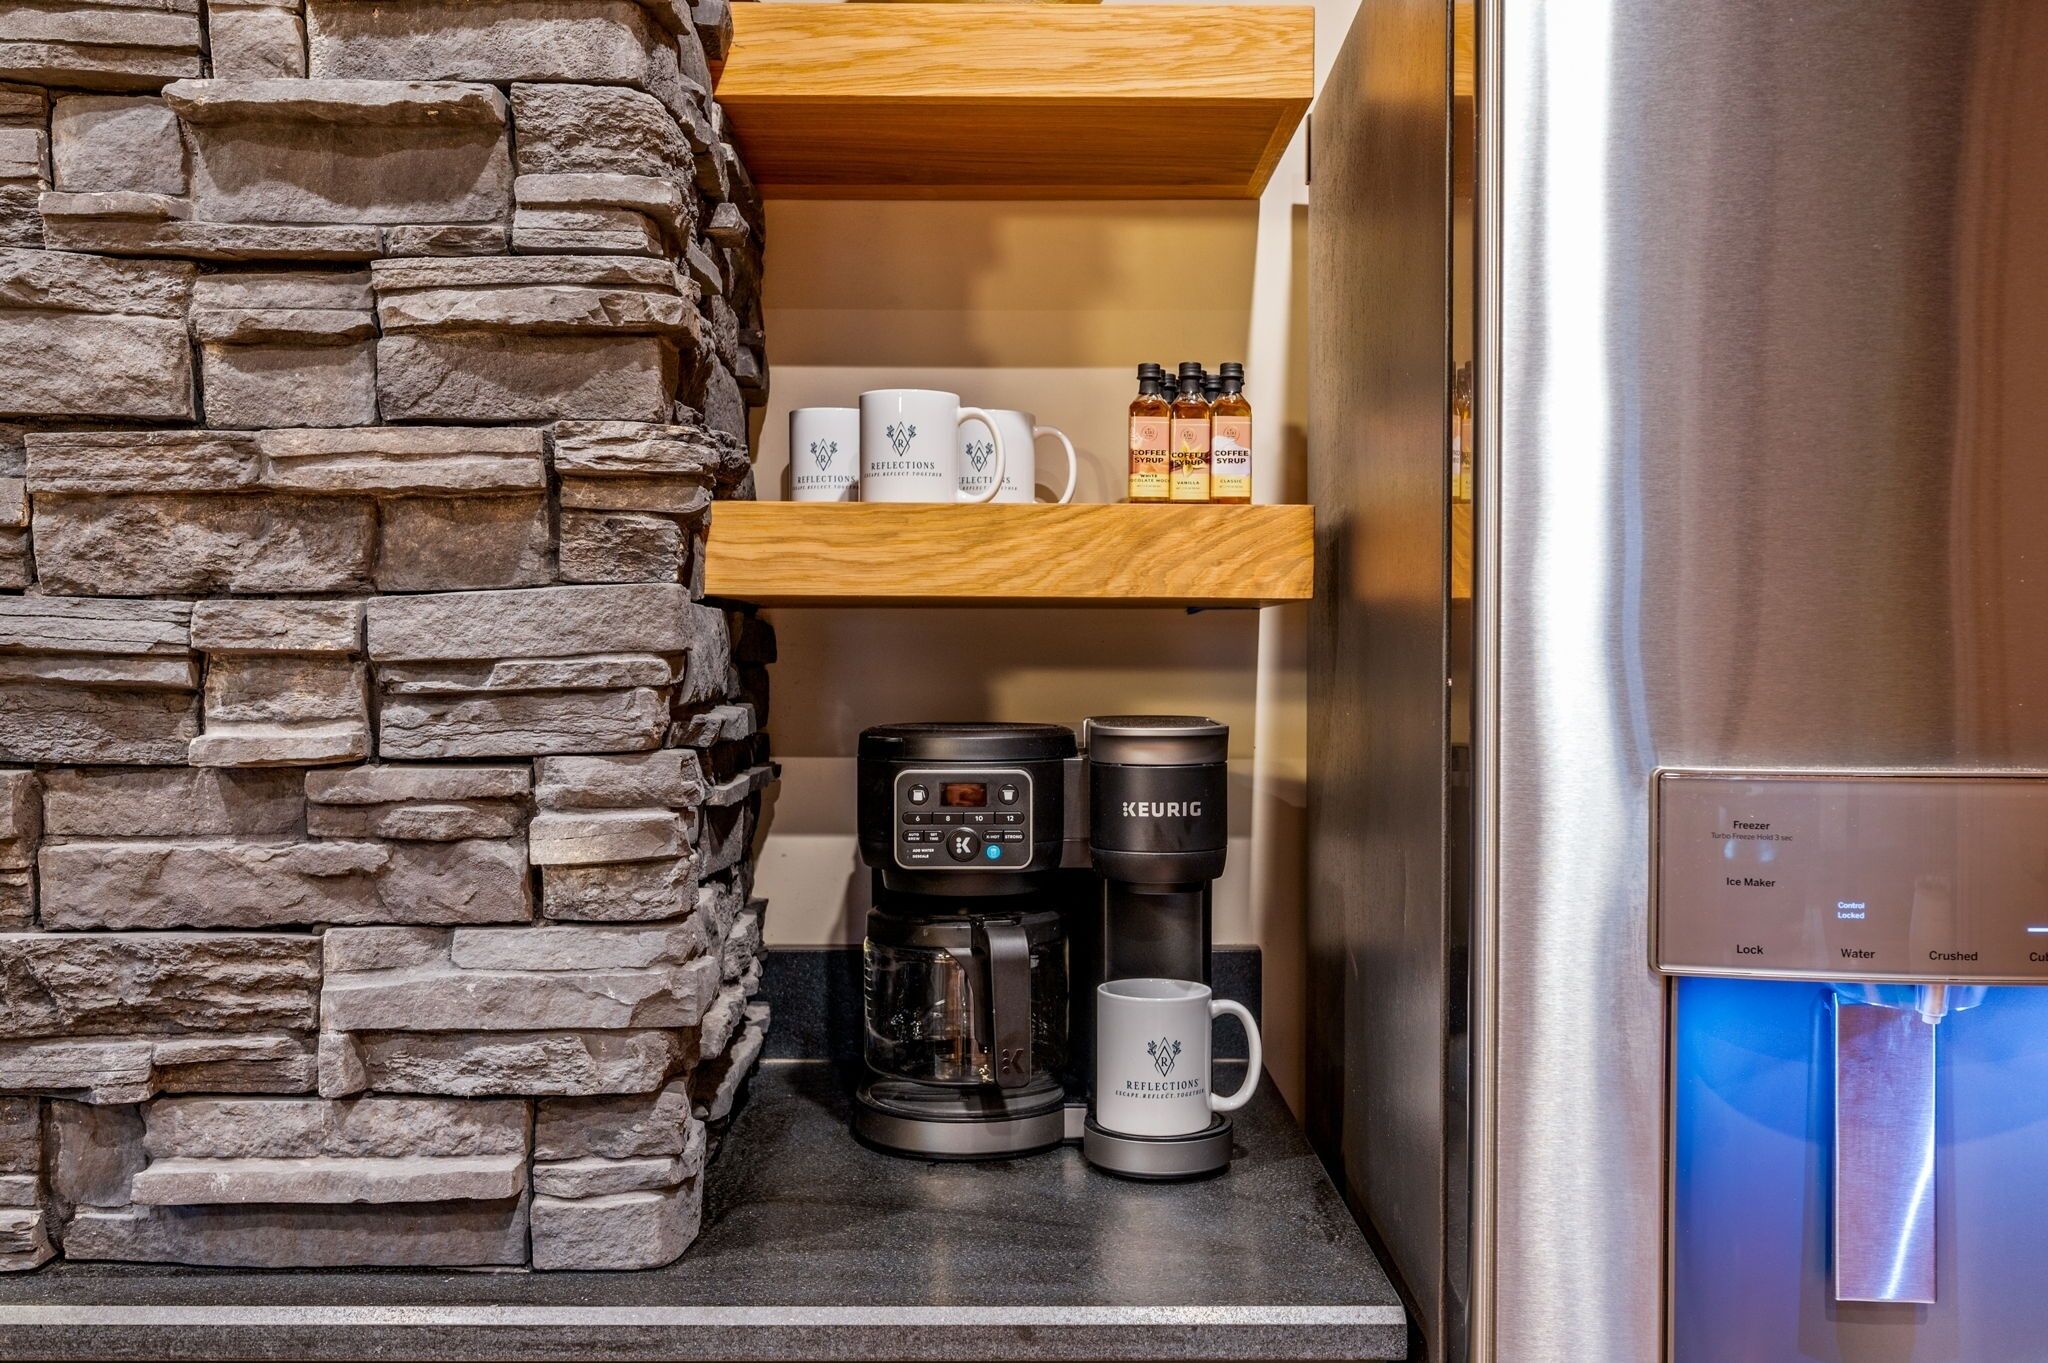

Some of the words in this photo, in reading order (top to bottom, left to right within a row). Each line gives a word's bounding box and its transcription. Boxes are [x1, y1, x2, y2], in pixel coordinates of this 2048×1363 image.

[1214, 449, 1249, 457] COFFEE
[871, 461, 935, 470] REFLECTIONS
[797, 475, 856, 484] REFLECTIONS
[1122, 801, 1202, 817] KEURIG
[1733, 820, 1770, 830] Freezer
[1711, 832, 1732, 840] Turbo
[1732, 832, 1755, 841] Freeze
[1756, 833, 1774, 841] Hold
[1726, 877, 1742, 886] Ice
[1743, 877, 1776, 887] Maker
[1837, 901, 1865, 910] Control
[1837, 911, 1865, 920] Locked
[1736, 944, 1764, 955] Lock
[1840, 948, 1876, 960] Water
[1928, 950, 1978, 962] Crushed
[1126, 1079, 1199, 1091] REFLECTIONS
